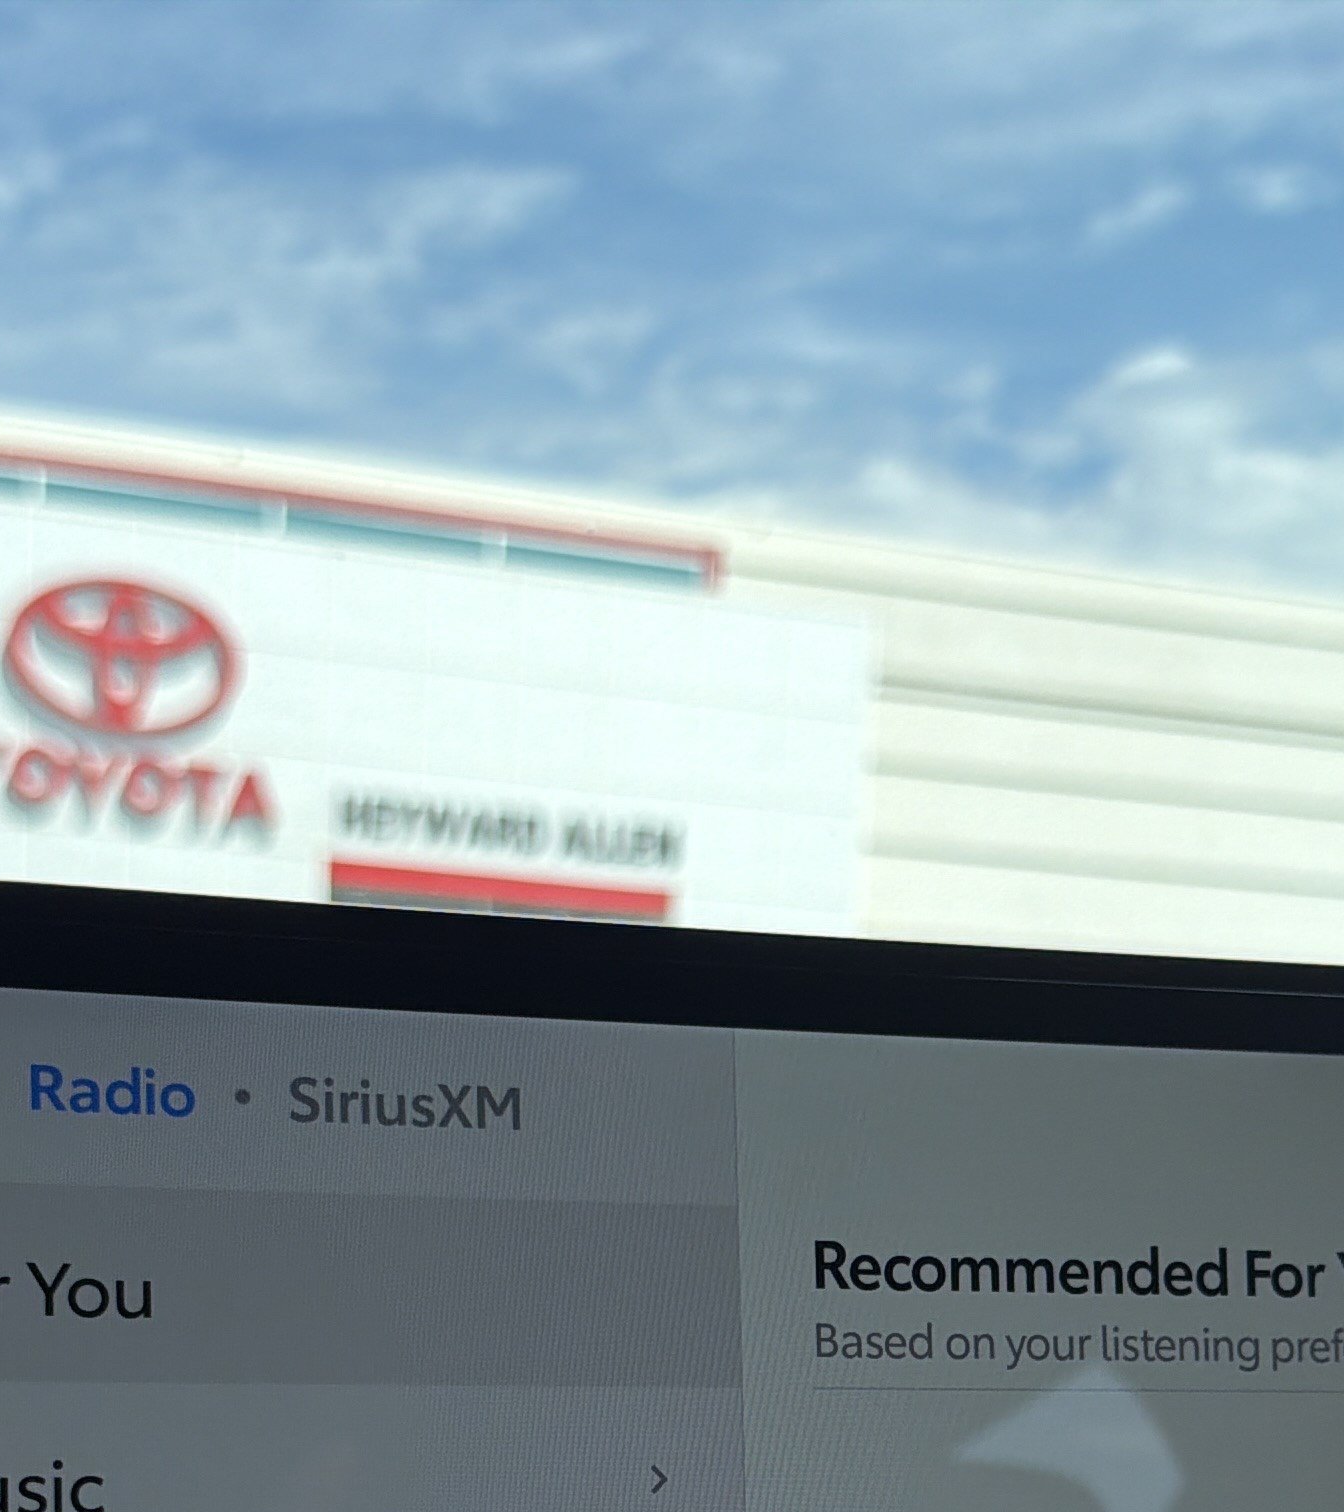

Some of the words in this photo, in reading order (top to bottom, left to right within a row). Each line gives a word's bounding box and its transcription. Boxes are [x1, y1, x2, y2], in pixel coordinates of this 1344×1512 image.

[338, 790, 546, 856] HEYWARD
[559, 812, 686, 870] ALLEN
[28, 1063, 197, 1119] Radio
[287, 1074, 524, 1132] SiriusXM
[25, 1262, 155, 1320] You
[812, 1238, 1230, 1299] Recommended
[1243, 1249, 1326, 1299] For
[813, 1322, 935, 1363] Based
[944, 1330, 997, 1363] on
[1003, 1330, 1091, 1370] your
[1099, 1323, 1261, 1372] listening
